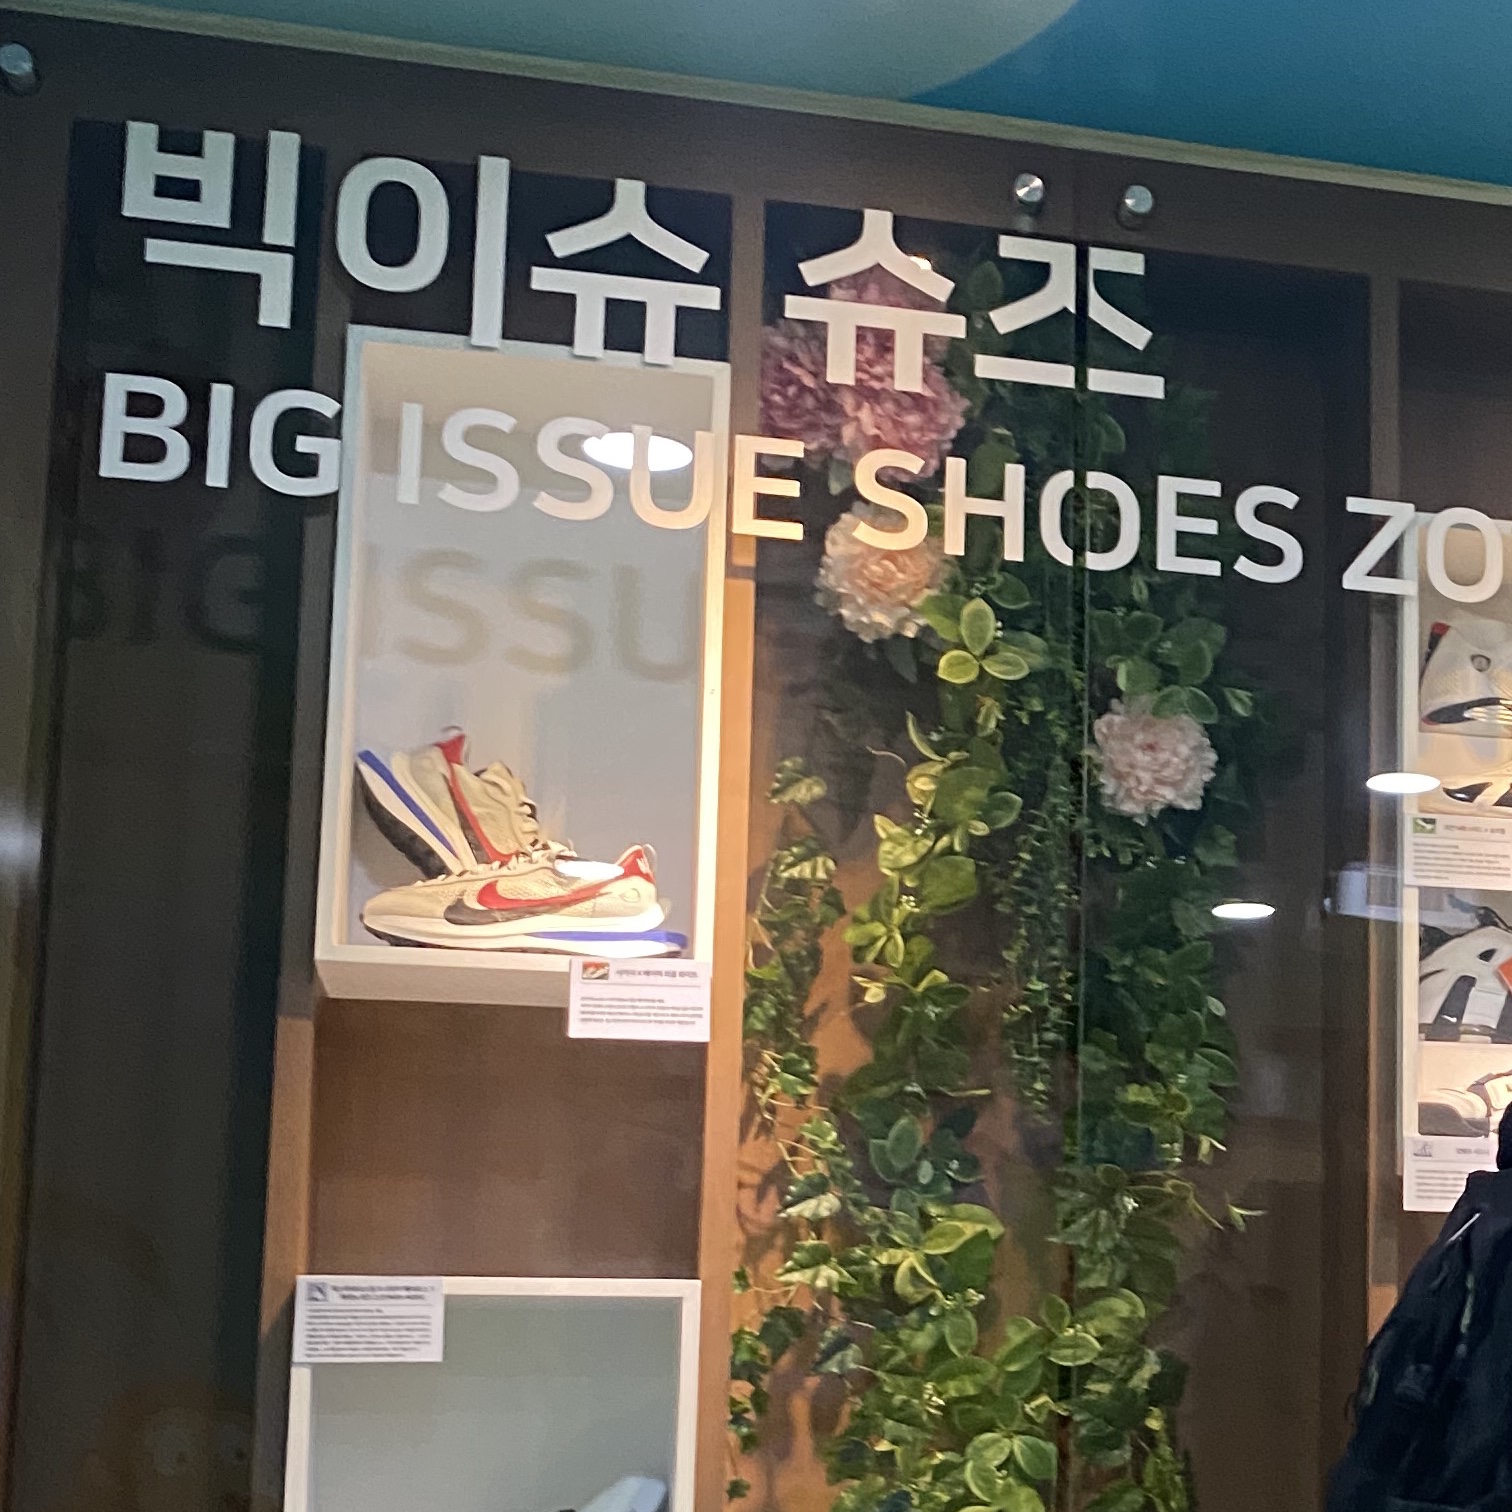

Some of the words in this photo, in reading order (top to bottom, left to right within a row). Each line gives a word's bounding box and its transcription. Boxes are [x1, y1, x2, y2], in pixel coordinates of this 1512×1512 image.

[121, 120, 722, 367] 빅이슈
[784, 208, 1166, 400] 슈즈
[99, 372, 342, 497] BIG
[398, 402, 806, 542] ISSUE
[852, 448, 1304, 584] SHOES
